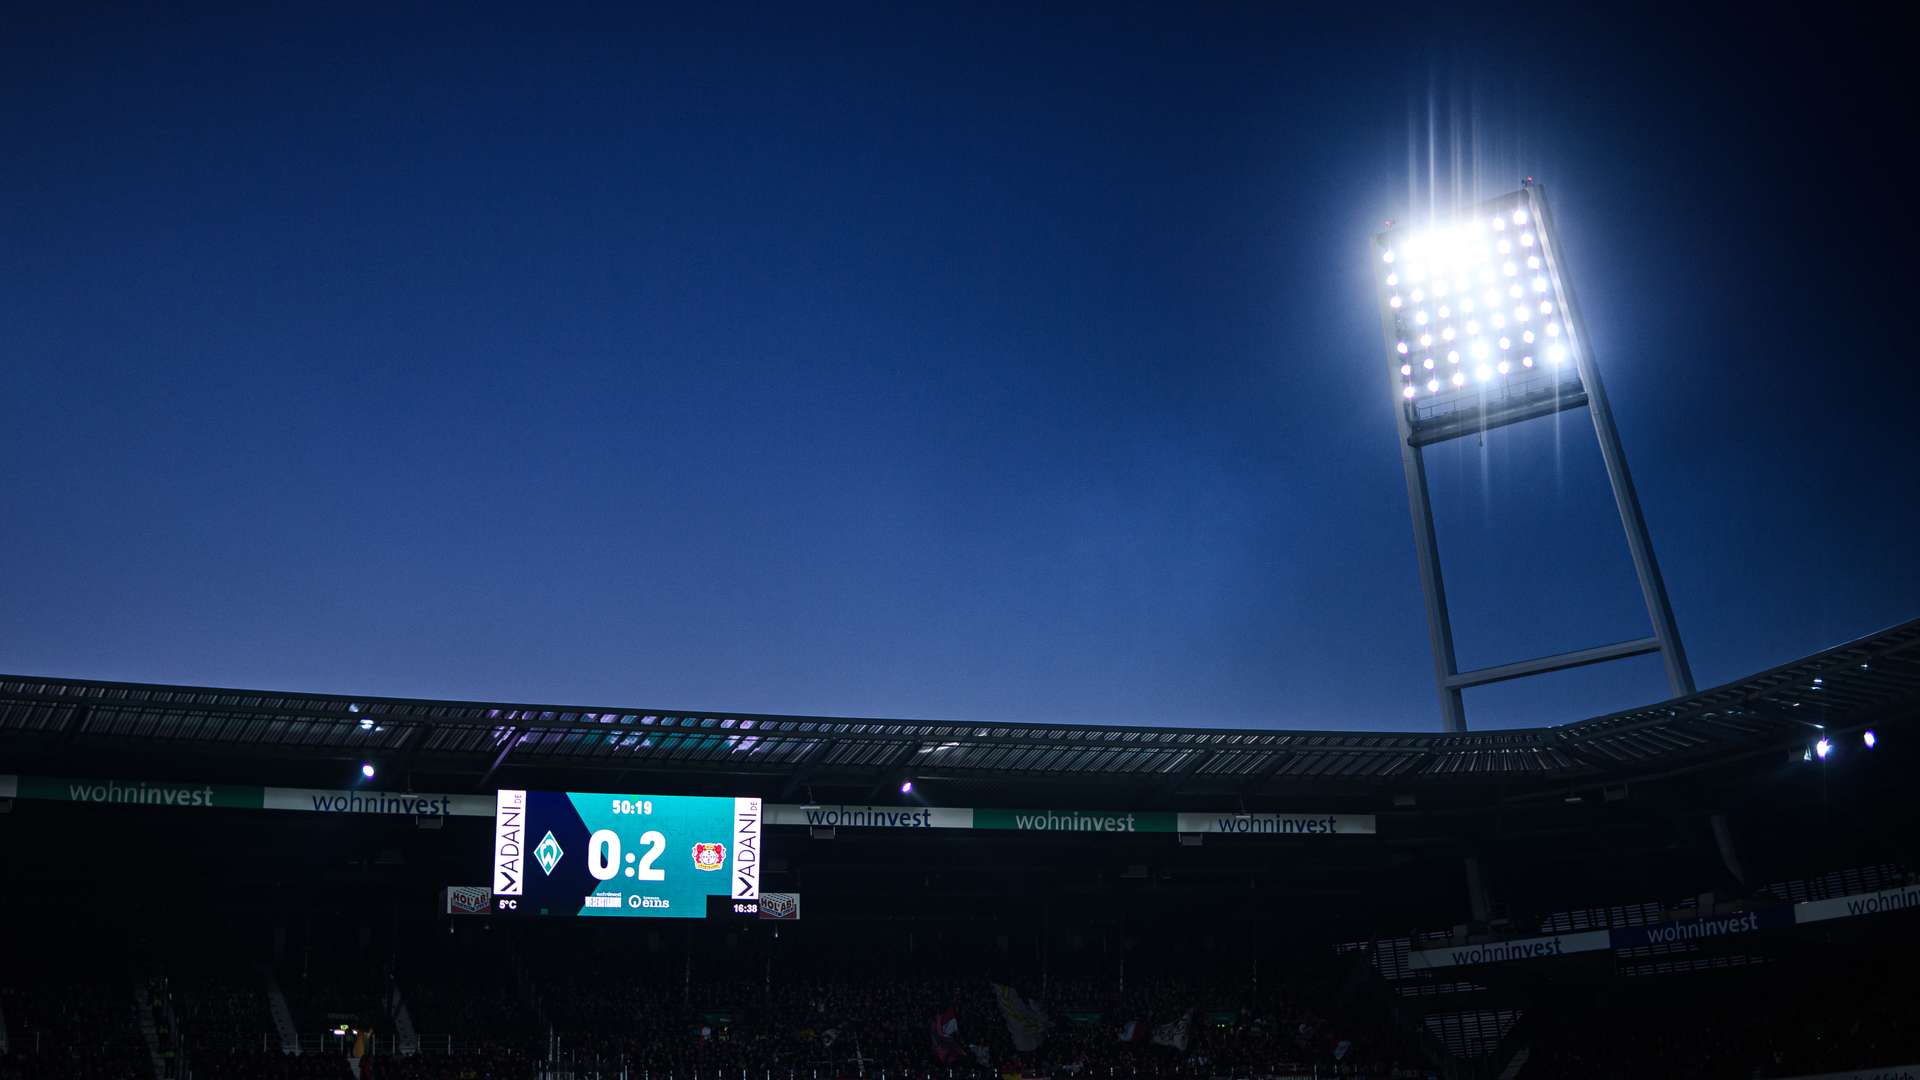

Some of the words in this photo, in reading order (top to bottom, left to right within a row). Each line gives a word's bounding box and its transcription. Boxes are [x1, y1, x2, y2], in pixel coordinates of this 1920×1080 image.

[68, 780, 214, 807] wohninvest
[312, 790, 451, 816] wohninvest
[611, 798, 653, 816] 50:19
[806, 806, 932, 829] wohninvest
[1015, 810, 1136, 833] wohninvest
[1219, 813, 1337, 835] wohninvest
[587, 829, 667, 882] 0:2
[499, 899, 517, 910] 5°C
[642, 899, 670, 908] eins
[733, 903, 758, 913] 16:38
[1647, 911, 1759, 945] wohninvest
[1451, 936, 1562, 966] wohninvest
